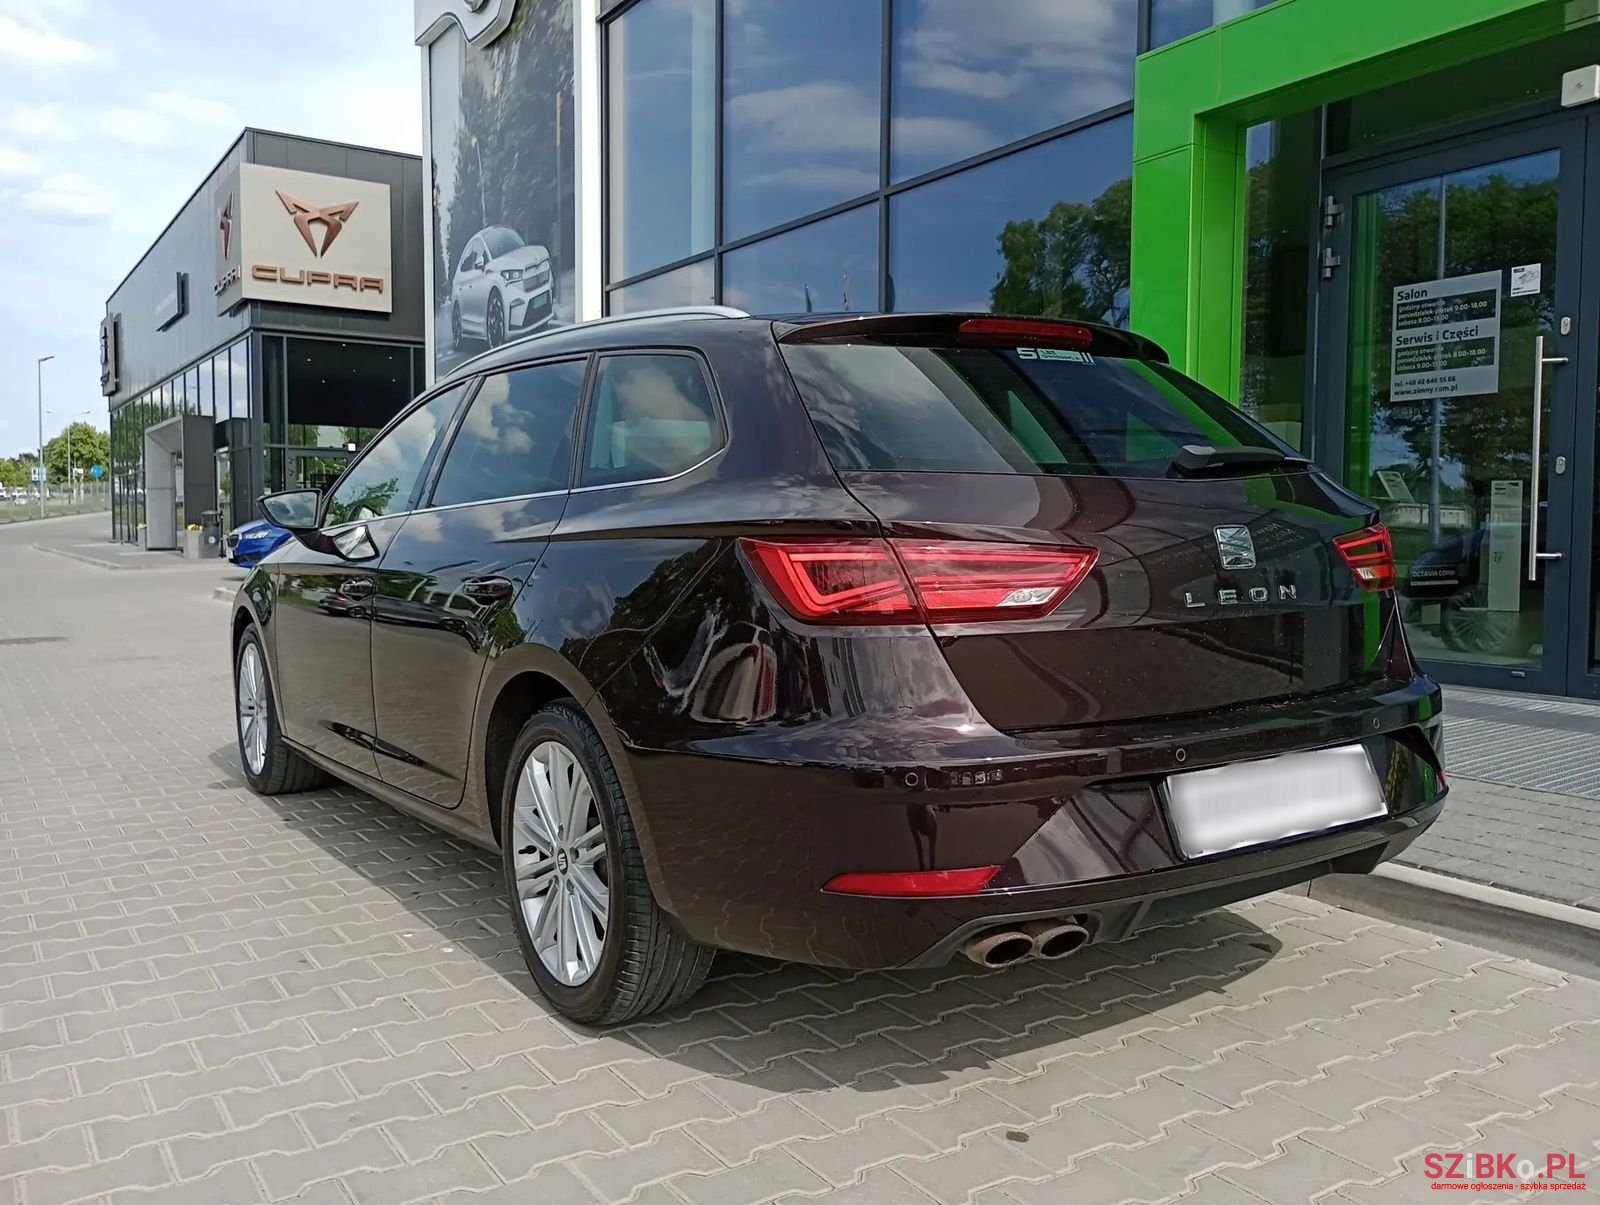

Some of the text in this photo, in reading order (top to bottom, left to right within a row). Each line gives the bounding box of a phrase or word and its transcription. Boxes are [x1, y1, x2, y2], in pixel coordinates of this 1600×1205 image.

[252, 264, 384, 294] CUPRA
[1397, 288, 1428, 301] Salon
[1398, 318, 1417, 327] sobota
[1395, 325, 1479, 346] Serwis i Części
[1184, 584, 1297, 608] LEON
